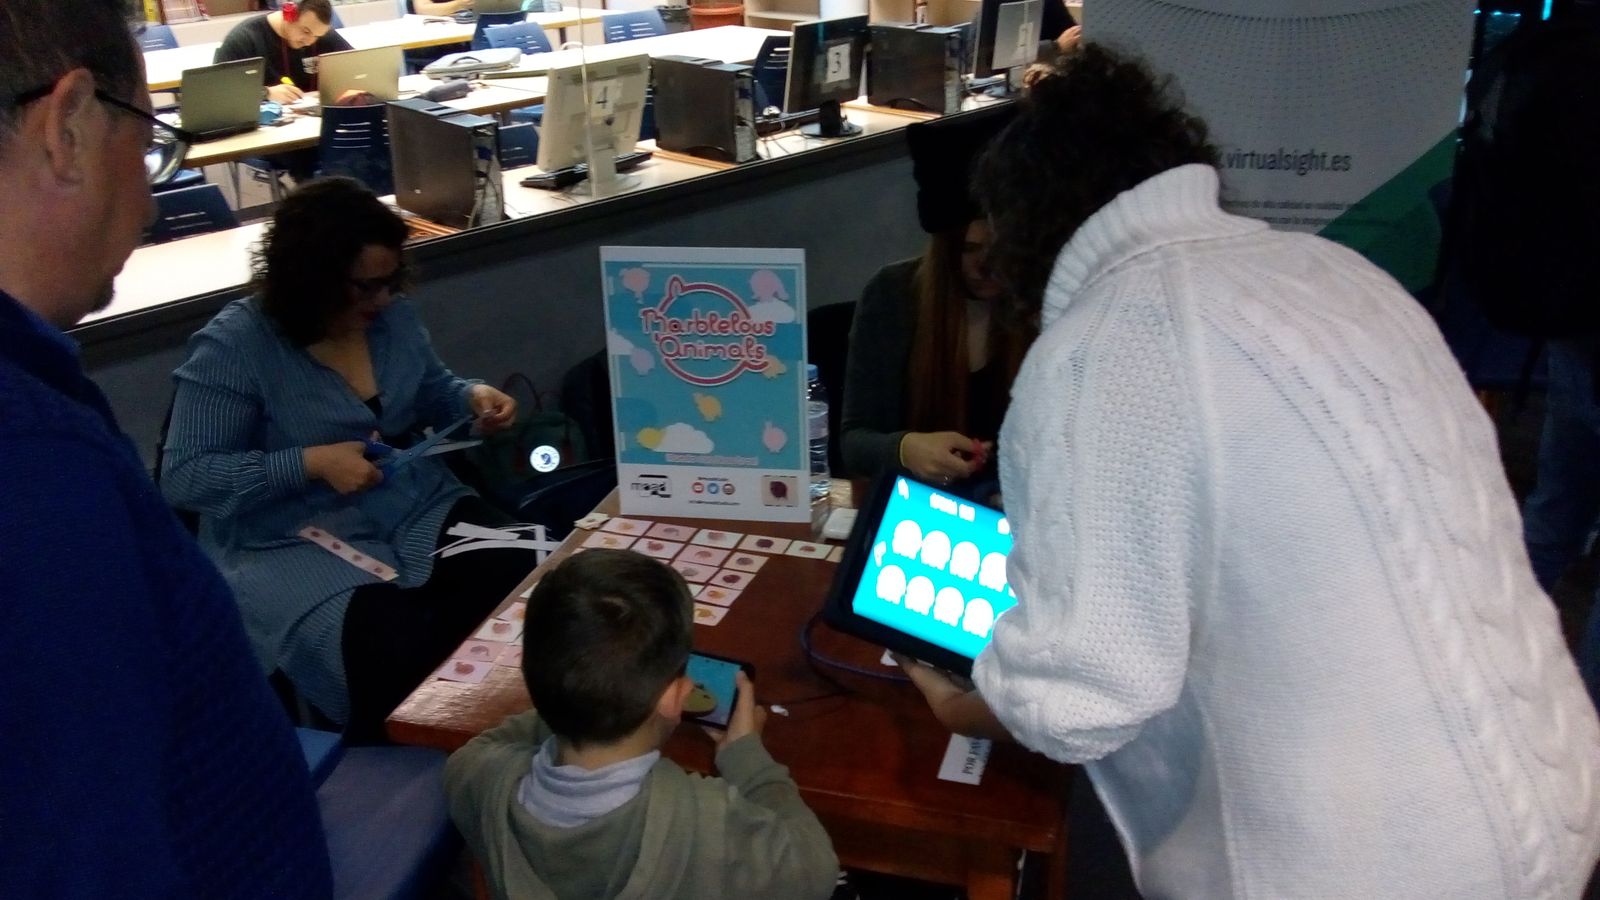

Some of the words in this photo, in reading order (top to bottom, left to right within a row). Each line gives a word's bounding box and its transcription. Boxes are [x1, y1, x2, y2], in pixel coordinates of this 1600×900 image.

[831, 51, 842, 74] 3
[595, 86, 608, 109] 4
[654, 333, 766, 360] Animals
